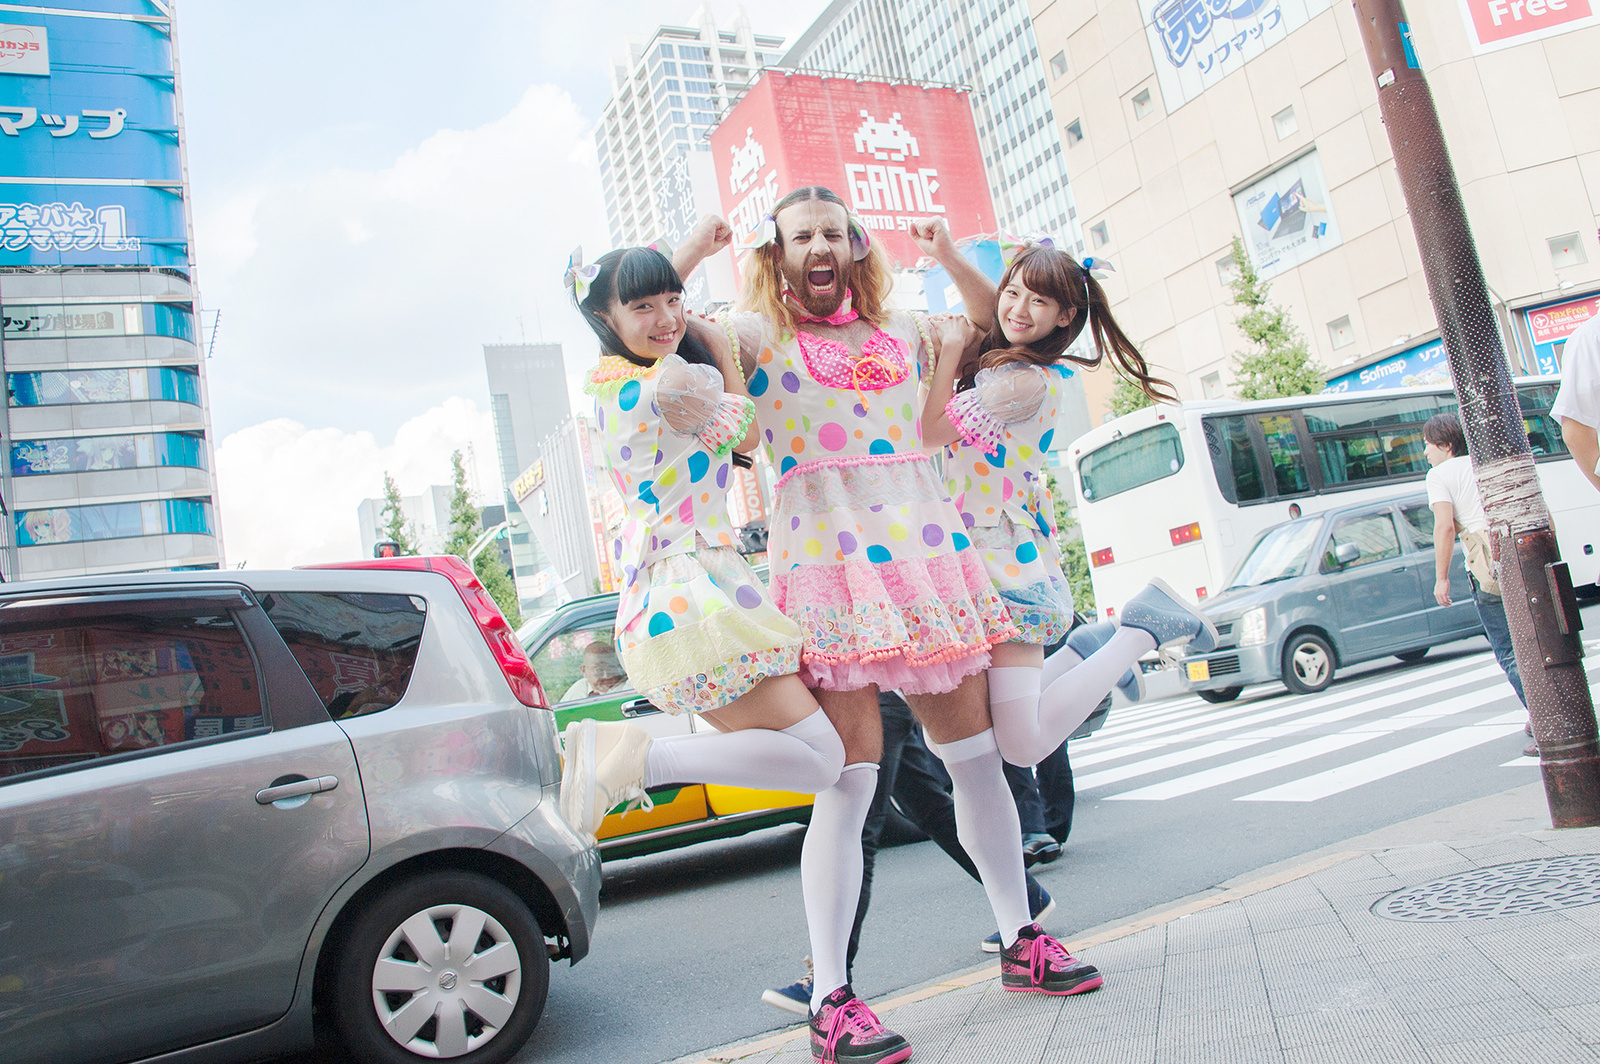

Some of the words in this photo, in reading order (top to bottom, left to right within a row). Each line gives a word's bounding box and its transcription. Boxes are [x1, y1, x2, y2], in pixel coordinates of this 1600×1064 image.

[1488, 0, 1568, 27] Free
[1198, 5, 1282, 75] ソフマップ
[0, 105, 127, 139] マップ
[845, 163, 946, 213] GAME
[1360, 360, 1407, 385] Sofmap
